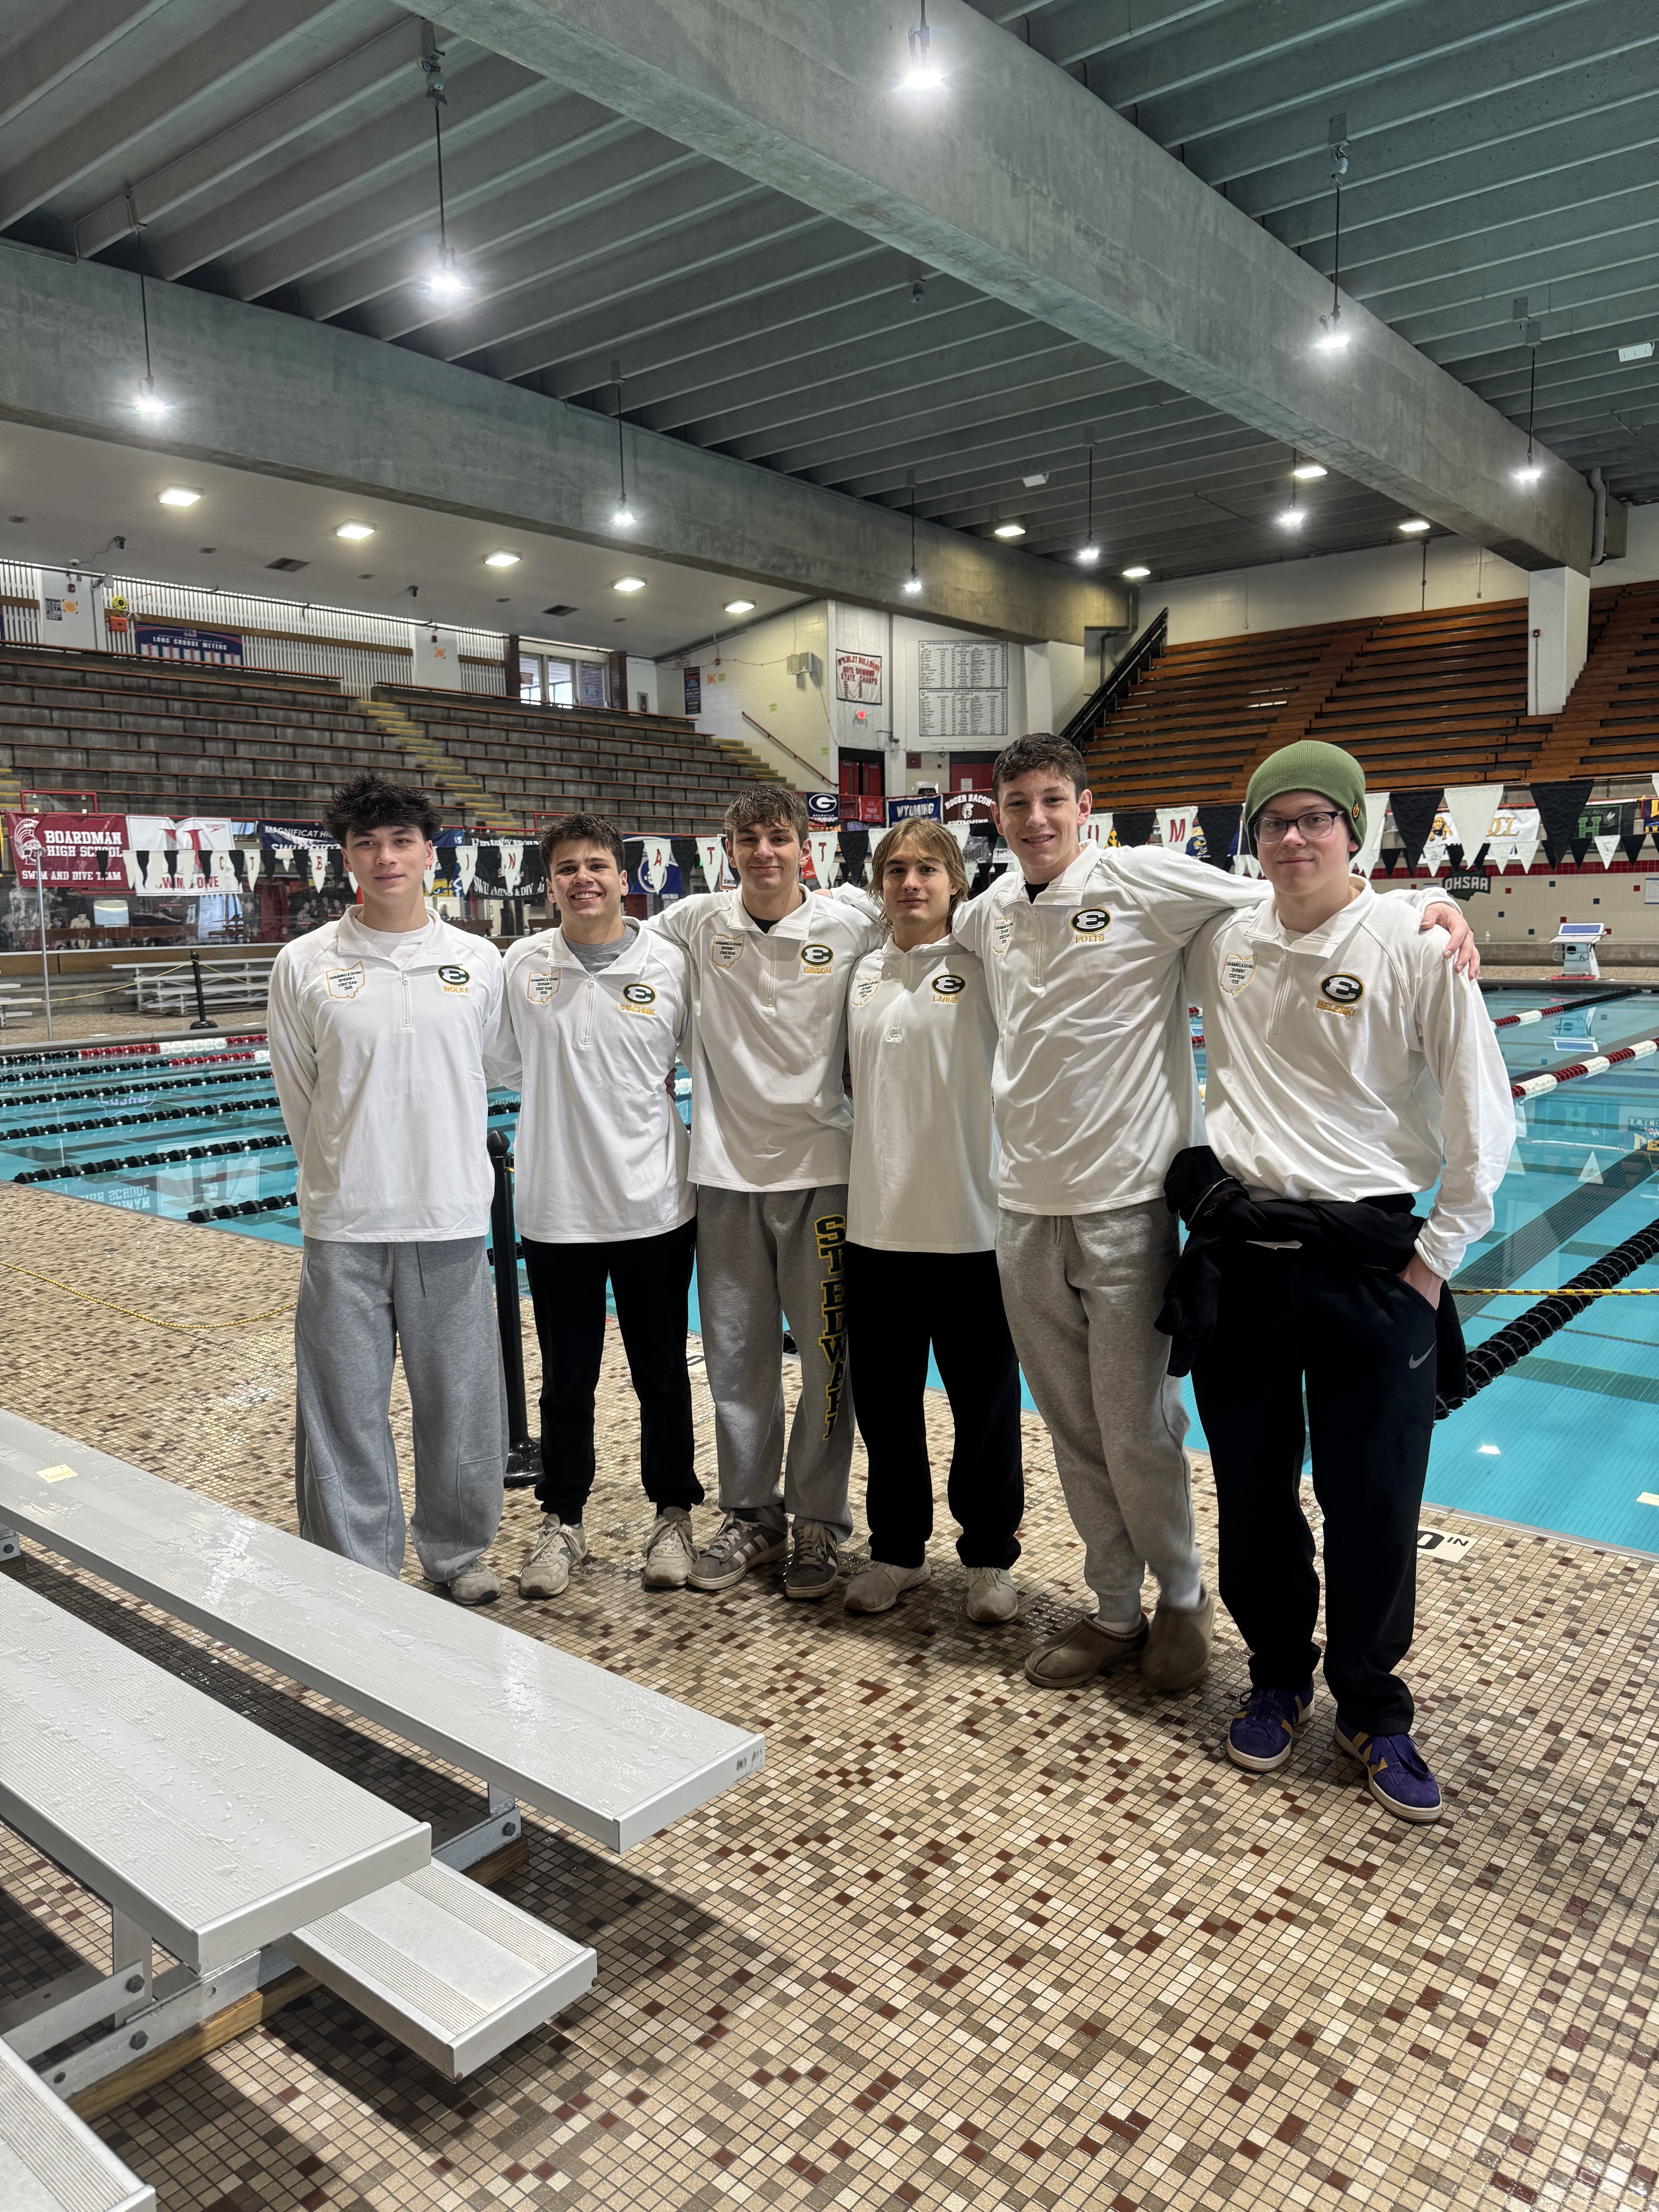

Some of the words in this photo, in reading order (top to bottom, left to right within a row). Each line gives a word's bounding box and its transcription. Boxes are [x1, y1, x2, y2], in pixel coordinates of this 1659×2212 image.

[945, 795, 967, 810] ROGER
[968, 794, 993, 807] BACON
[896, 803, 934, 817] WYOMING
[44, 830, 122, 845] BOARDMAN
[264, 825, 319, 838] MAGNIFICAT
[1169, 819, 1186, 843] M
[46, 845, 76, 857] HIGH
[79, 846, 123, 857] SCOL
[653, 849, 662, 866] A
[707, 847, 715, 865] T
[818, 842, 826, 862] T
[316, 856, 322, 870] B
[508, 853, 516, 869] N
[51, 871, 69, 880] AND
[72, 871, 93, 880] DIVE
[96, 871, 122, 880] TAM
[1445, 876, 1489, 891] OHSAA
[1076, 911, 1105, 929] E
[1075, 934, 1104, 943] POTTS
[805, 947, 829, 962] E
[443, 986, 469, 994] WOLKE
[936, 977, 962, 991] E
[1325, 977, 1360, 1000] E
[627, 986, 651, 1001] E
[932, 995, 958, 1004] LARUE
[1446, 1537, 1469, 1547] IN
